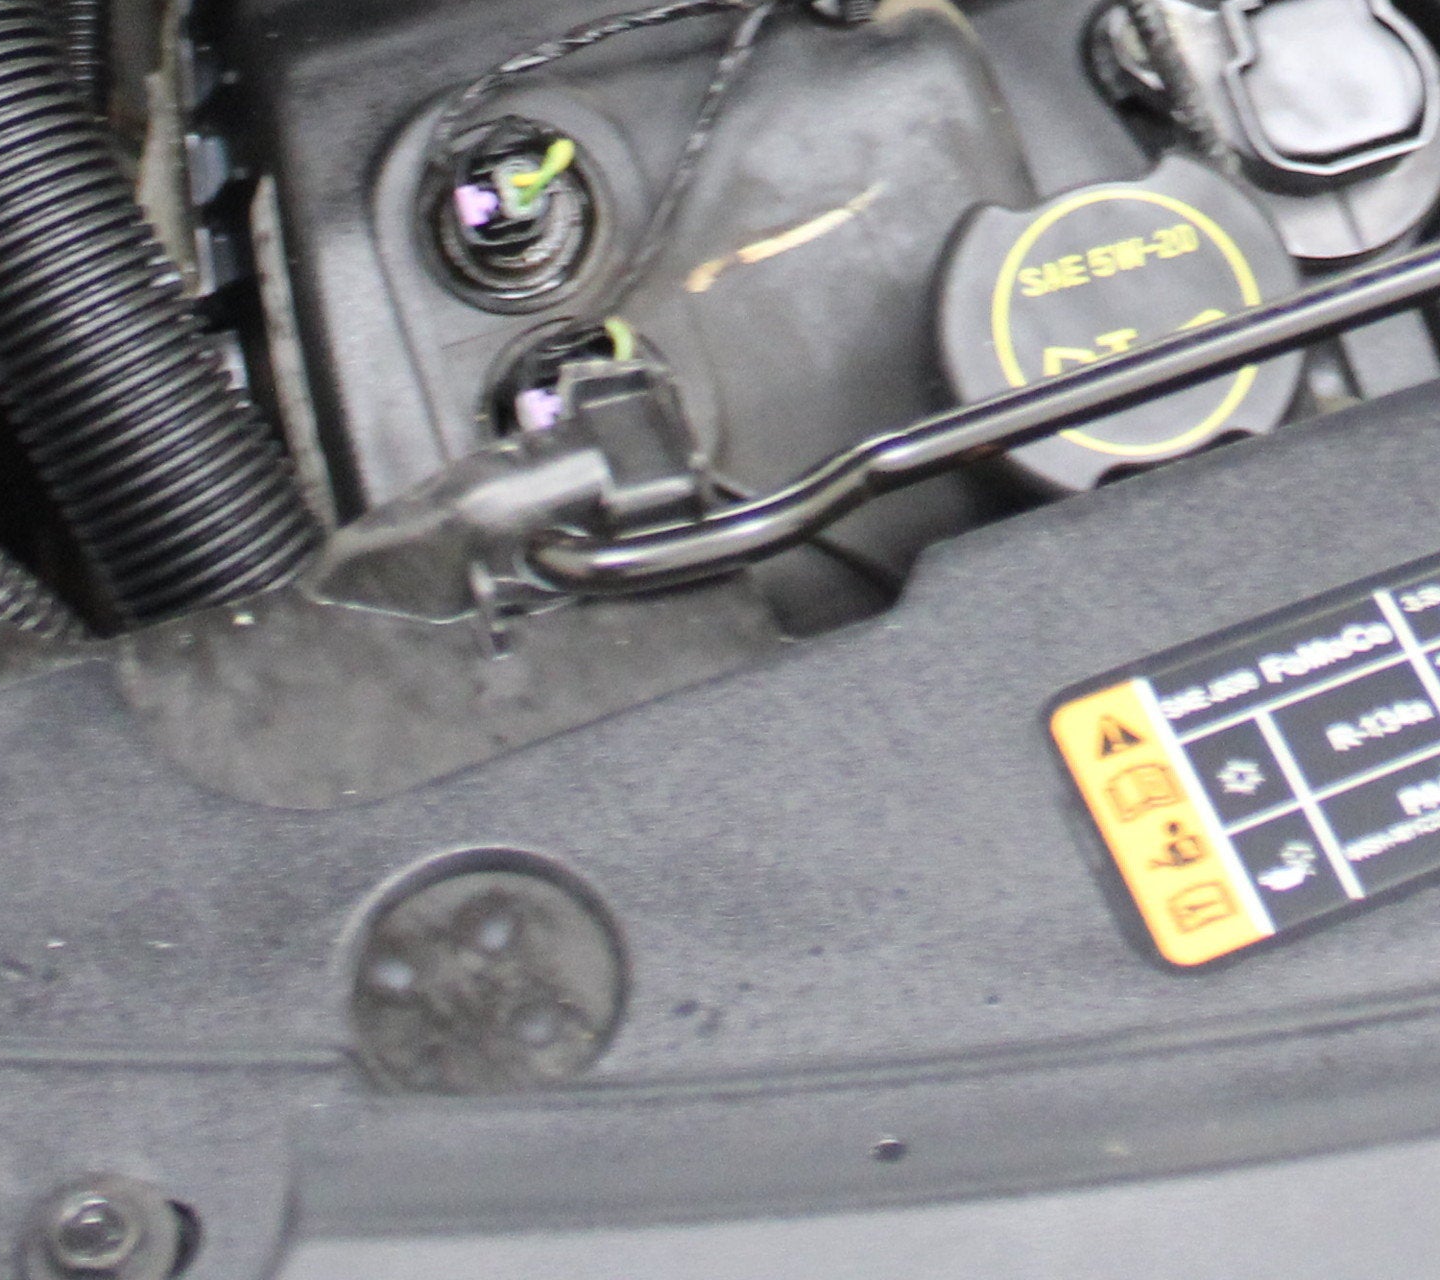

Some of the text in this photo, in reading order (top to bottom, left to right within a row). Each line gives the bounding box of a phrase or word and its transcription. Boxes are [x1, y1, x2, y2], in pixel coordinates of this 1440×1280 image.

[1017, 223, 1201, 298] SAE 5W-20
[1259, 623, 1394, 683] FoMoCo
[1326, 700, 1433, 751] R-134a
